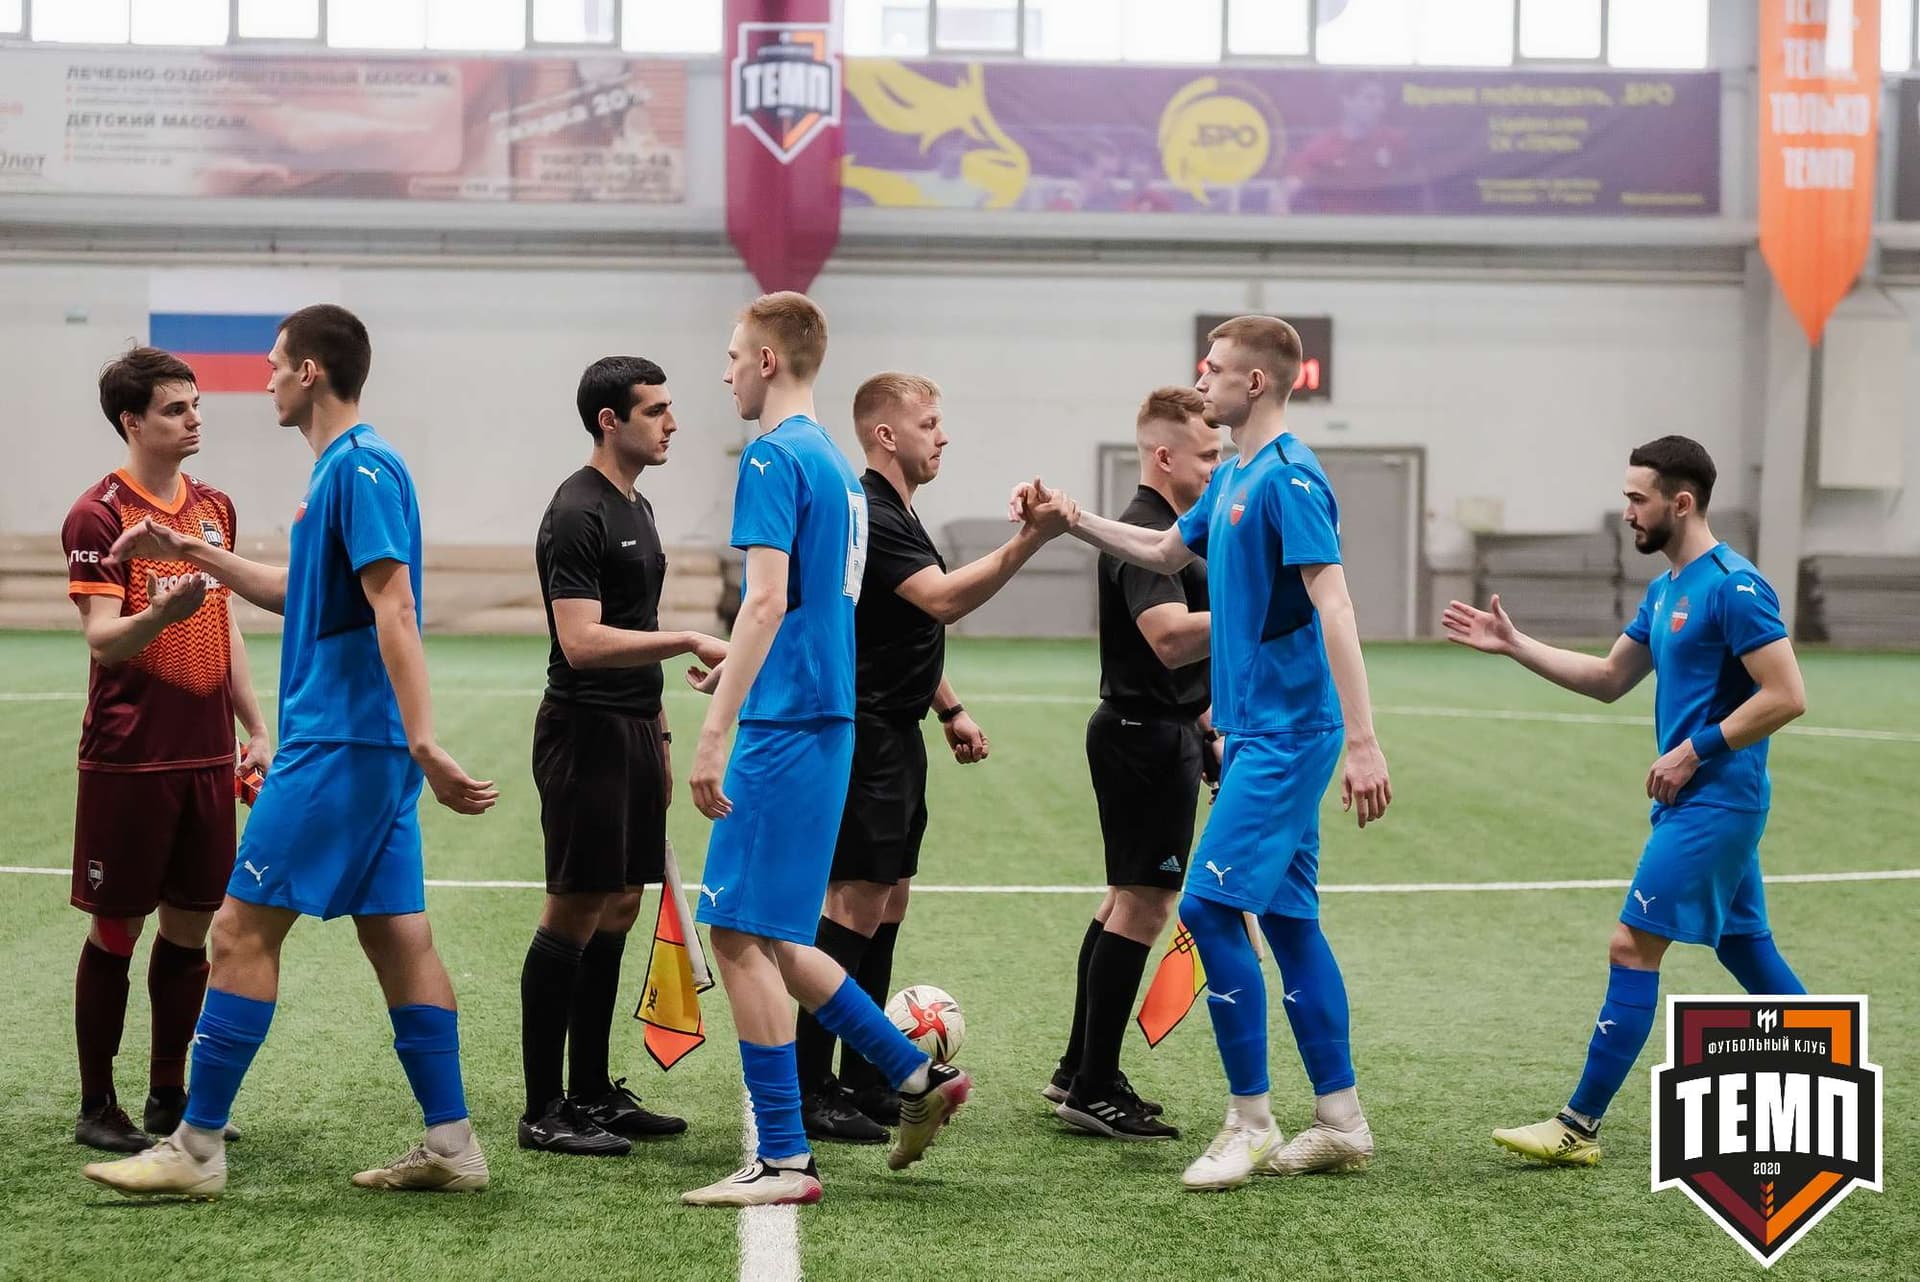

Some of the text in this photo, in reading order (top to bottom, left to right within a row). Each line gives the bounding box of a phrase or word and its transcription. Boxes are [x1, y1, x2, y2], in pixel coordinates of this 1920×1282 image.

[742, 62, 830, 109] ТЕМП
[66, 112, 156, 128] ДЕТСКИЙ
[1769, 93, 1870, 136] ТОЛЬКО
[71, 549, 99, 564] ПСБ
